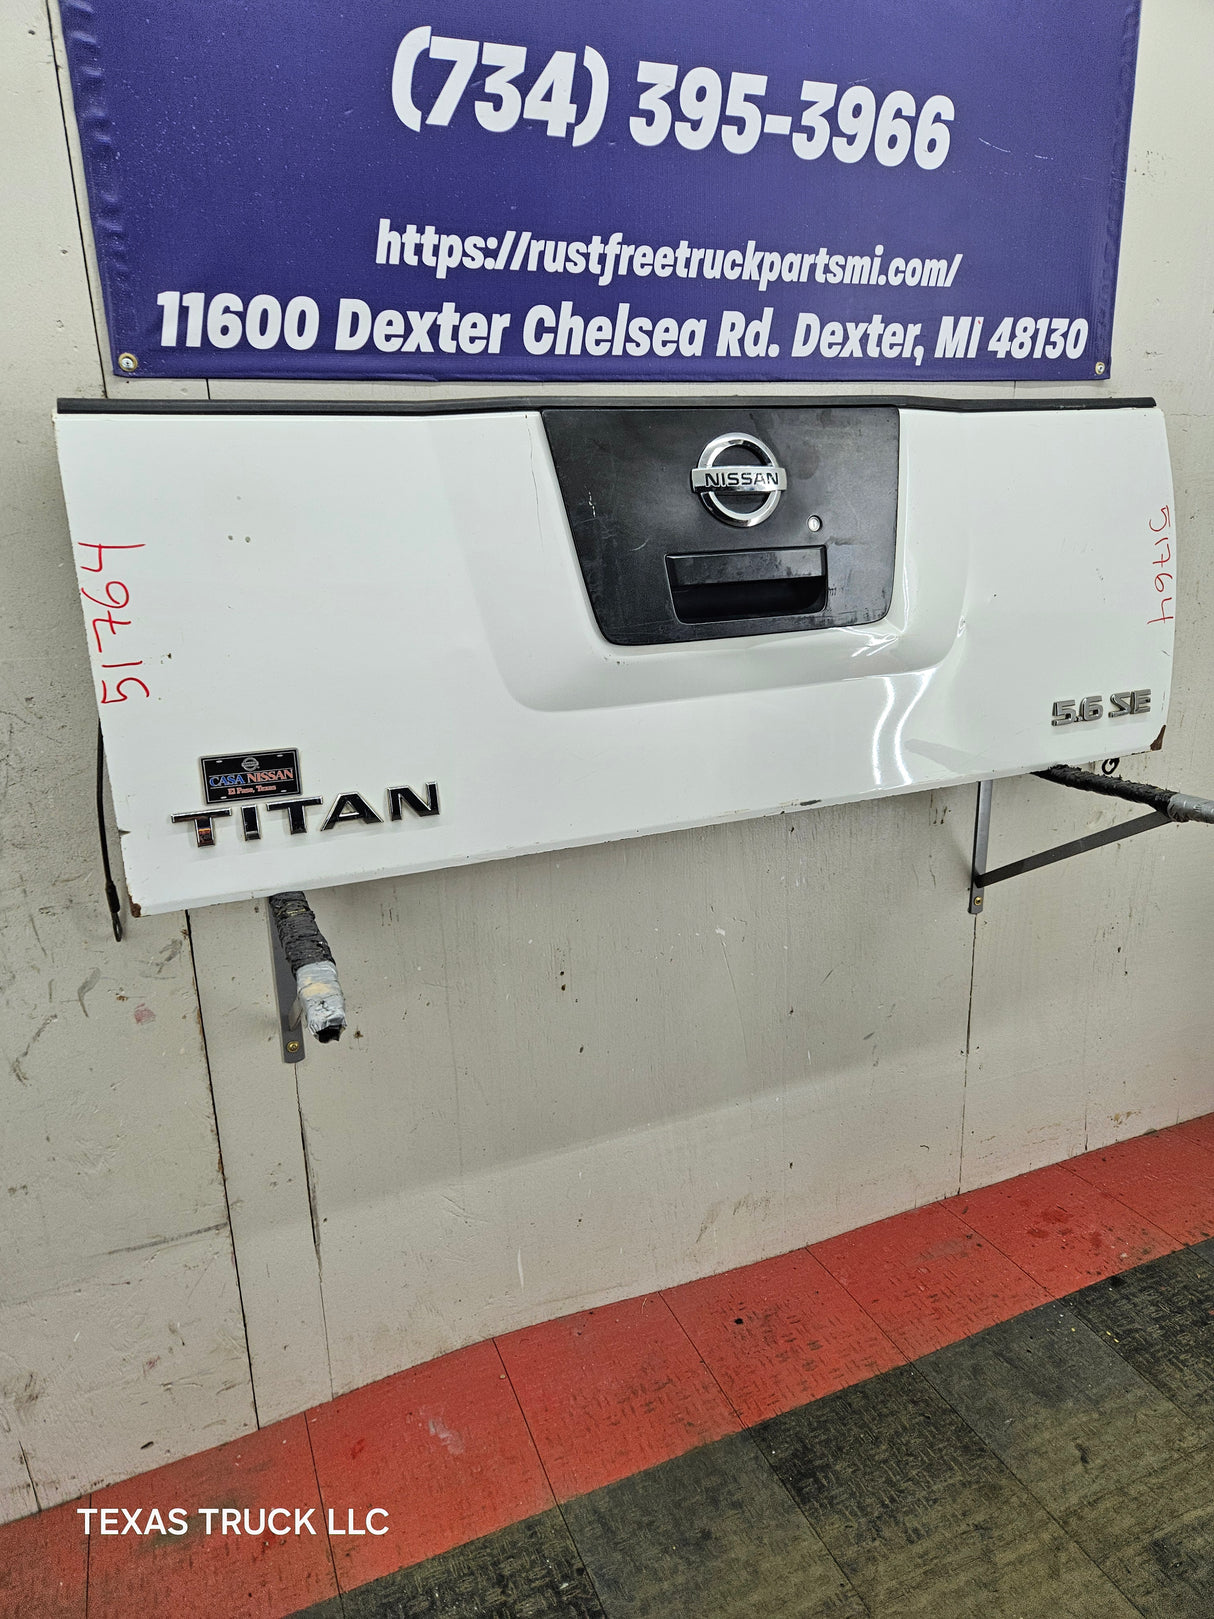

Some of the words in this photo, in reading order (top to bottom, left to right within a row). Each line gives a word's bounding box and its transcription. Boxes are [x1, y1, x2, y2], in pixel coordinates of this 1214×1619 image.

[392, 26, 609, 146] (734)
[629, 61, 955, 170] 395-3966
[376, 218, 964, 292] https://rustfreetruckpartsmi.com/
[157, 291, 319, 350] 11600
[335, 299, 510, 354] Dexter
[523, 301, 707, 357] Chelsea
[716, 307, 779, 358] Rd.
[792, 313, 924, 366] Dexter,
[934, 316, 984, 359] MI
[987, 317, 1089, 360] 48130
[704, 472, 779, 487] NISSAN
[1146, 504, 1174, 625] 51764
[77, 541, 150, 704] 51764
[1051, 695, 1104, 727] 5.6
[1108, 689, 1152, 718] SE
[171, 781, 440, 847] TITAN
[209, 774, 246, 787] CASA
[247, 769, 294, 783] NISSAN
